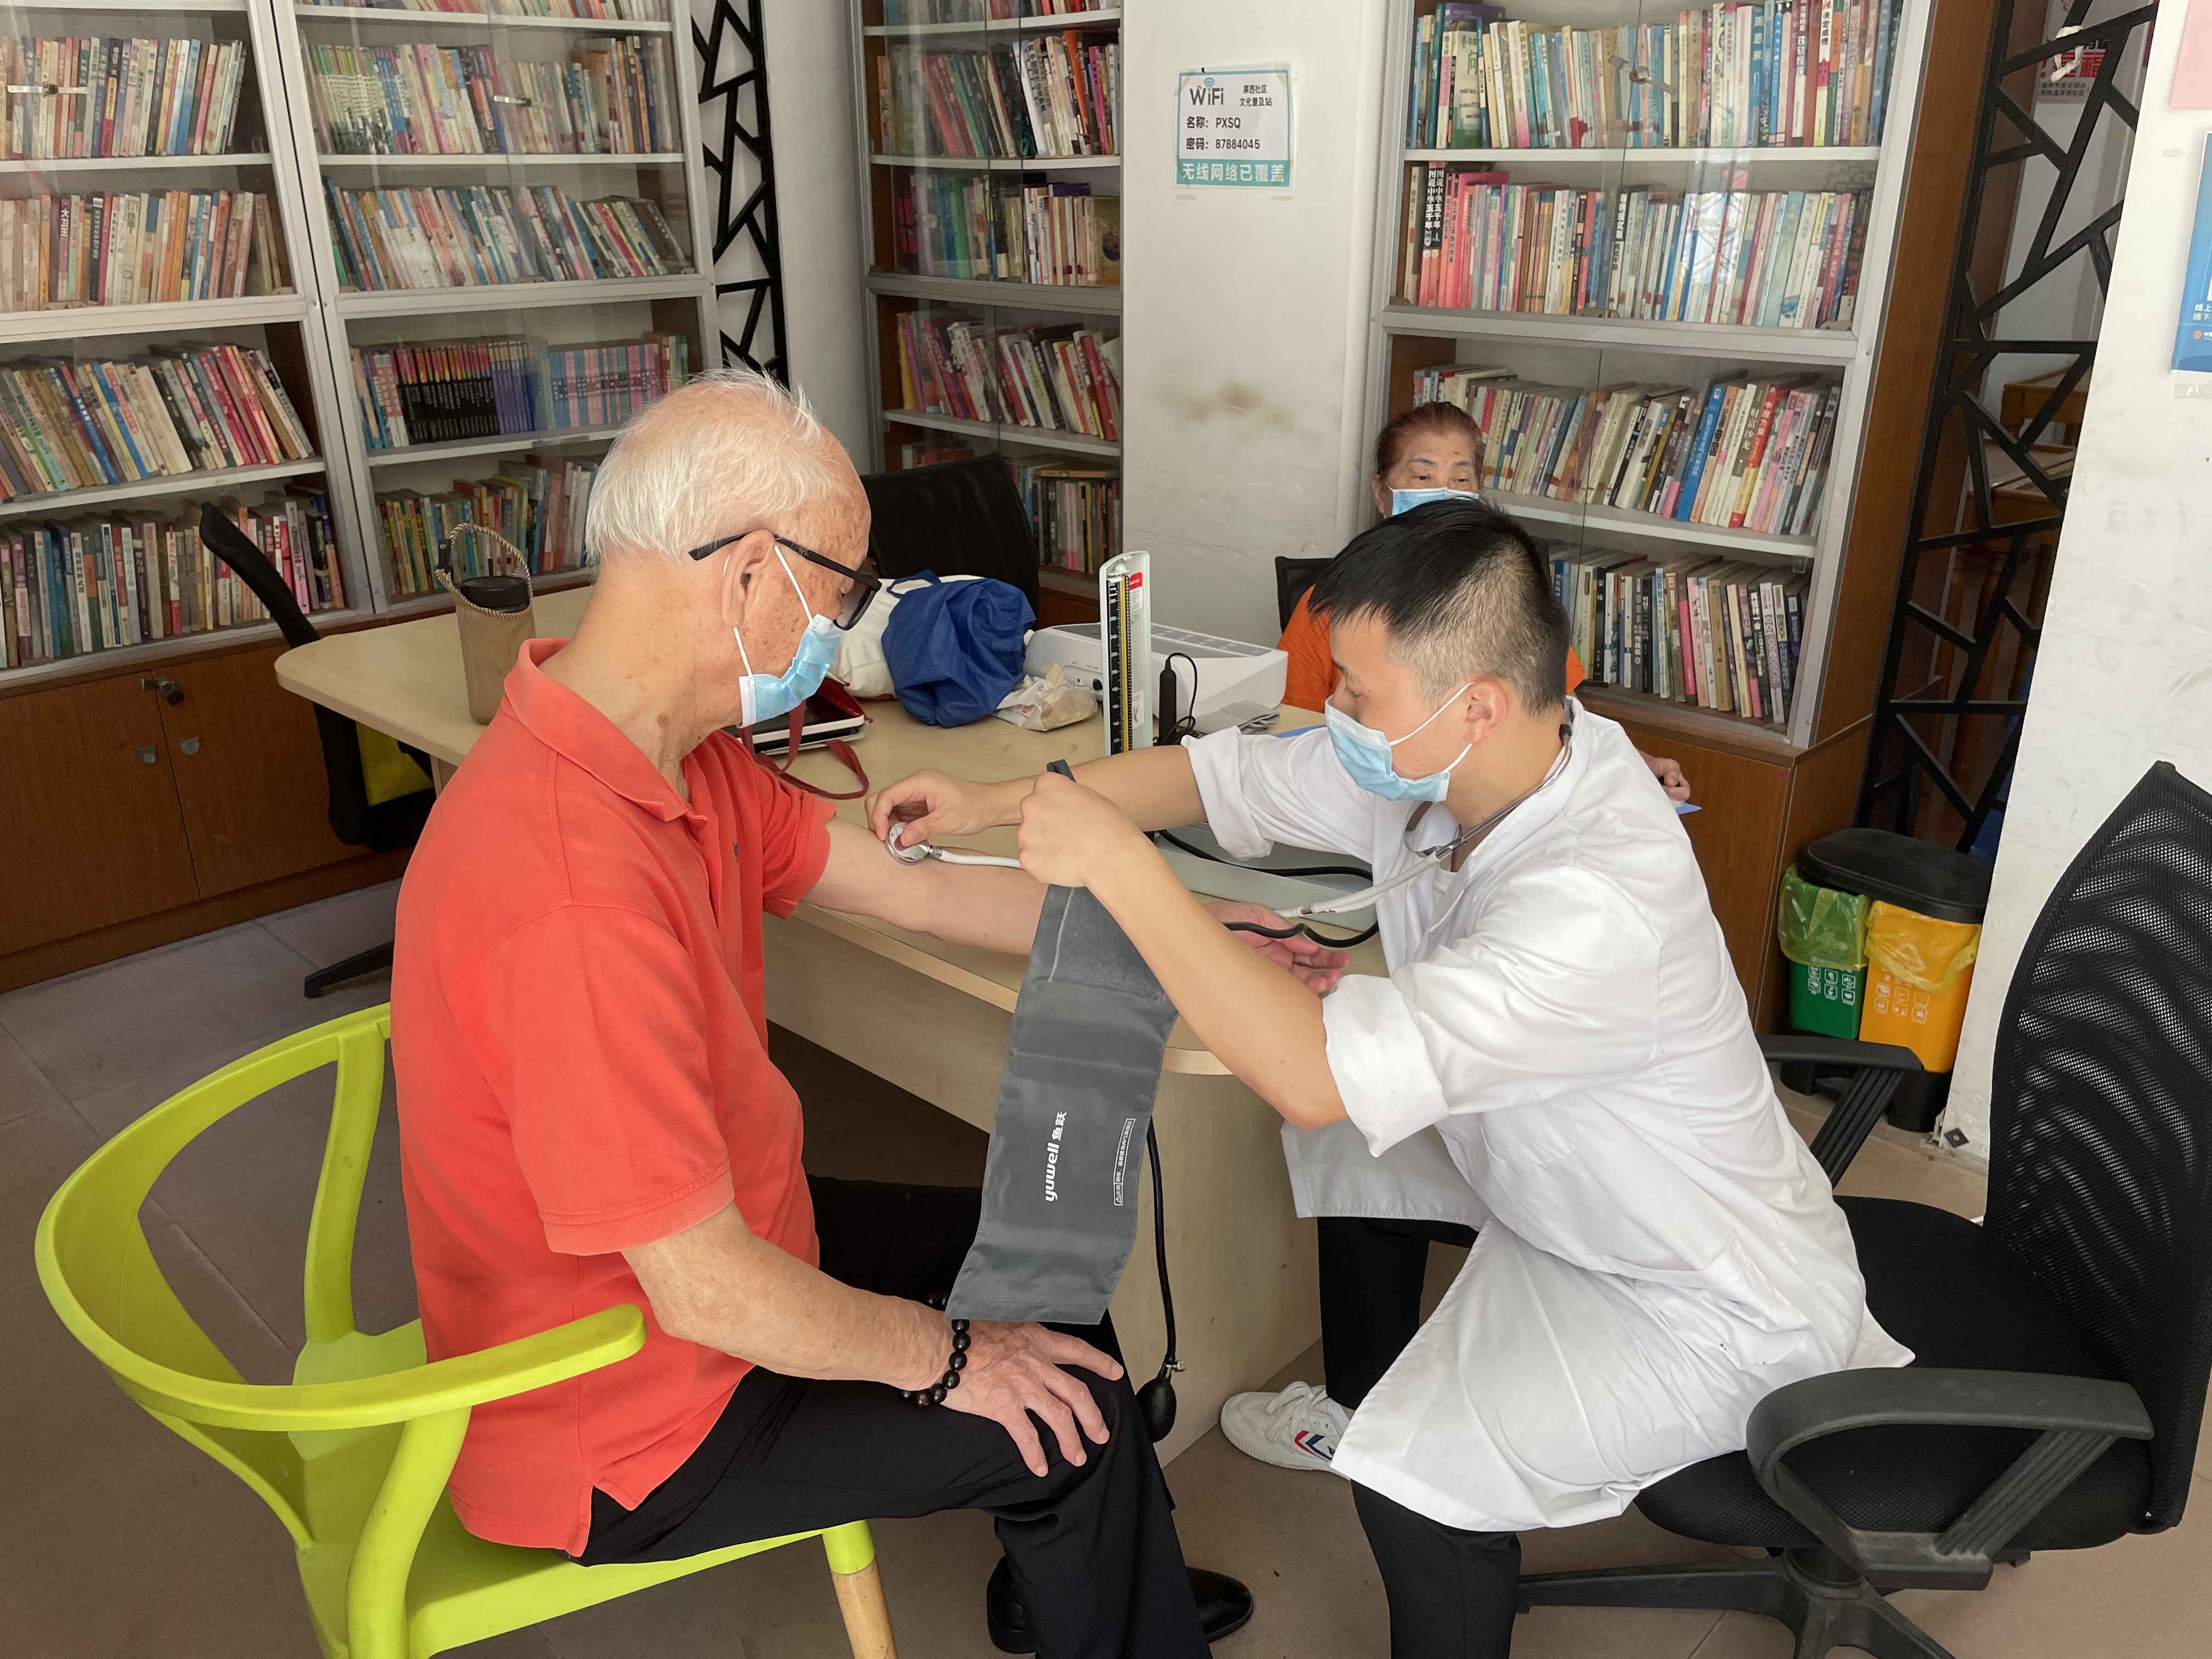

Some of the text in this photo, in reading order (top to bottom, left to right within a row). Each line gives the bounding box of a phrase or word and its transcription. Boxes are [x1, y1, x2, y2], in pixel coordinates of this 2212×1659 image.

[1189, 87, 1224, 105] WiFi
[1215, 117, 1241, 129] PXSQ
[1215, 139, 1260, 150] 87884045
[1182, 163, 1285, 183] 无线网络已覆盖
[1045, 1142, 1060, 1203] yuwell
